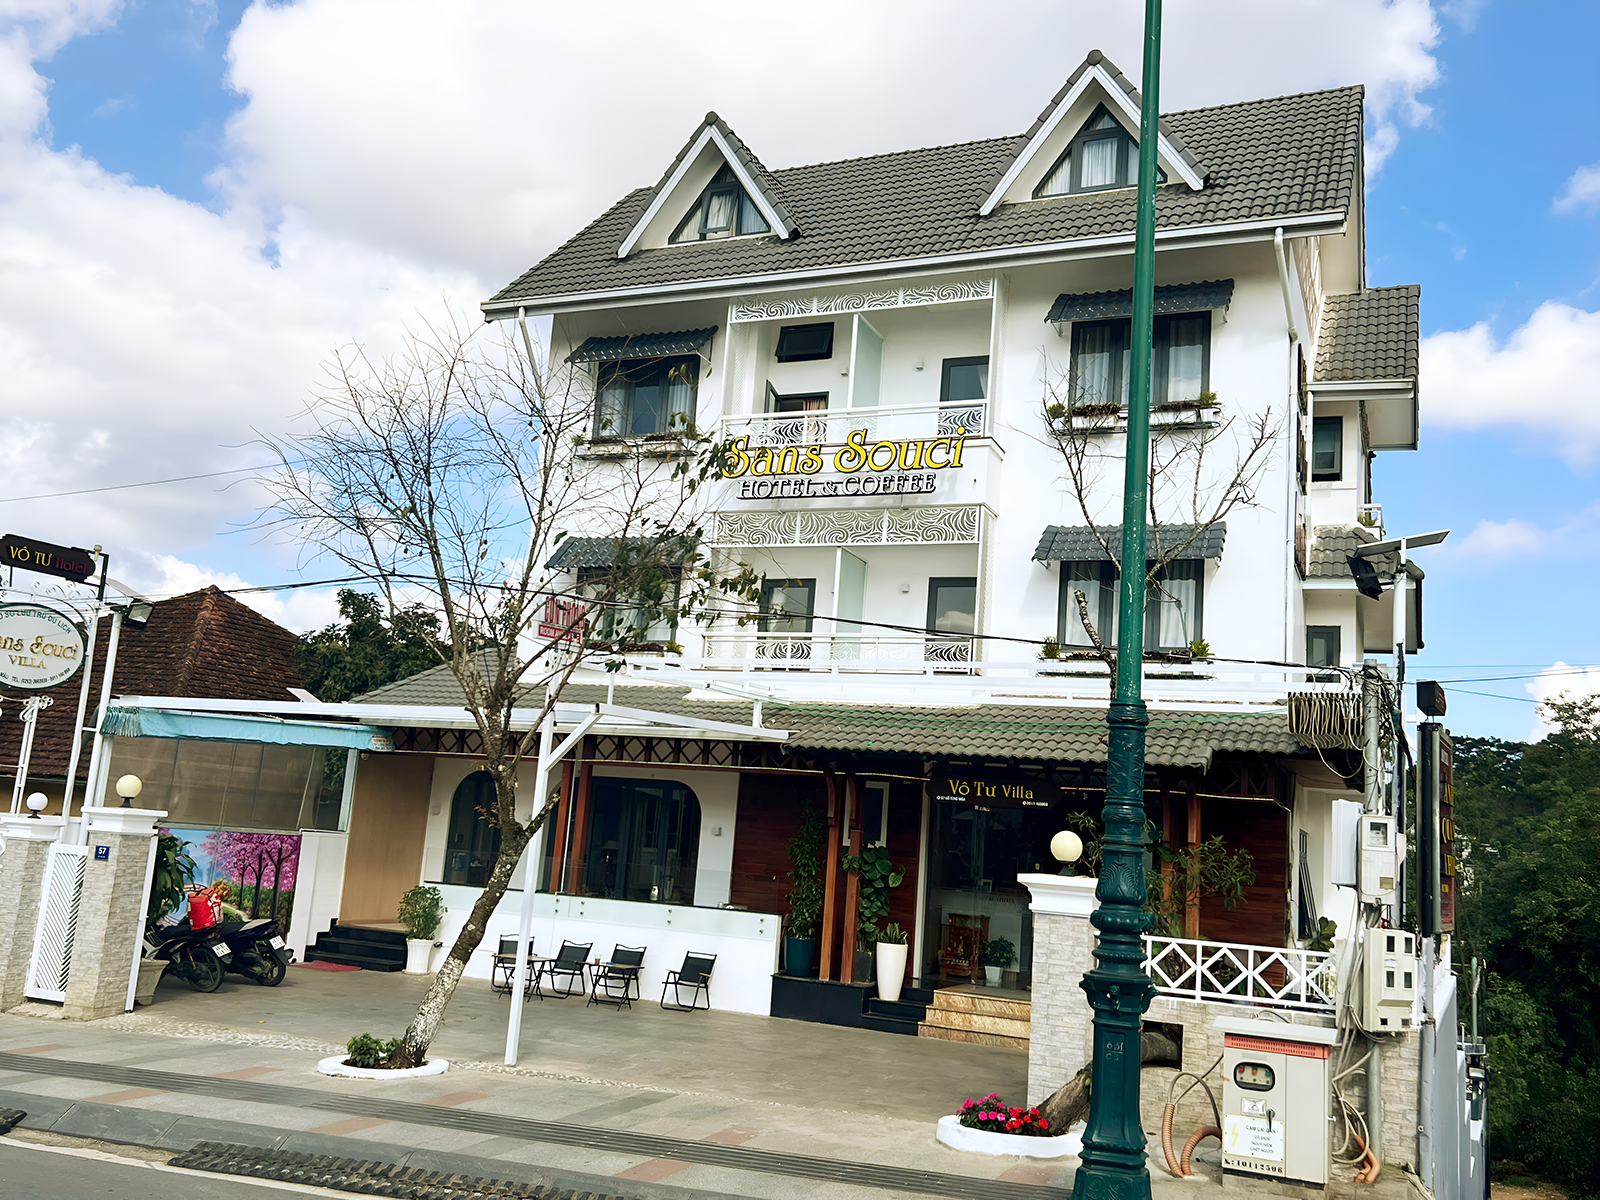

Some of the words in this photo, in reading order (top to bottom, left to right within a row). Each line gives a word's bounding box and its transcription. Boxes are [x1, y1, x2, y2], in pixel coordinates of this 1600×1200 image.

[722, 435, 824, 478] Sans
[834, 426, 967, 474] Souci
[737, 477, 816, 499] HOTEL
[820, 482, 837, 496] &
[842, 473, 937, 495] COFFEE
[10, 545, 30, 561] VÔ
[34, 550, 53, 567] TƯ
[55, 557, 87, 574] Hotel
[29, 634, 78, 660] Souci
[8, 654, 46, 669] VILLA
[948, 779, 970, 796] Vô
[973, 781, 996, 797] Tư
[1002, 784, 1034, 799] Villa
[98, 847, 107, 855] 57
